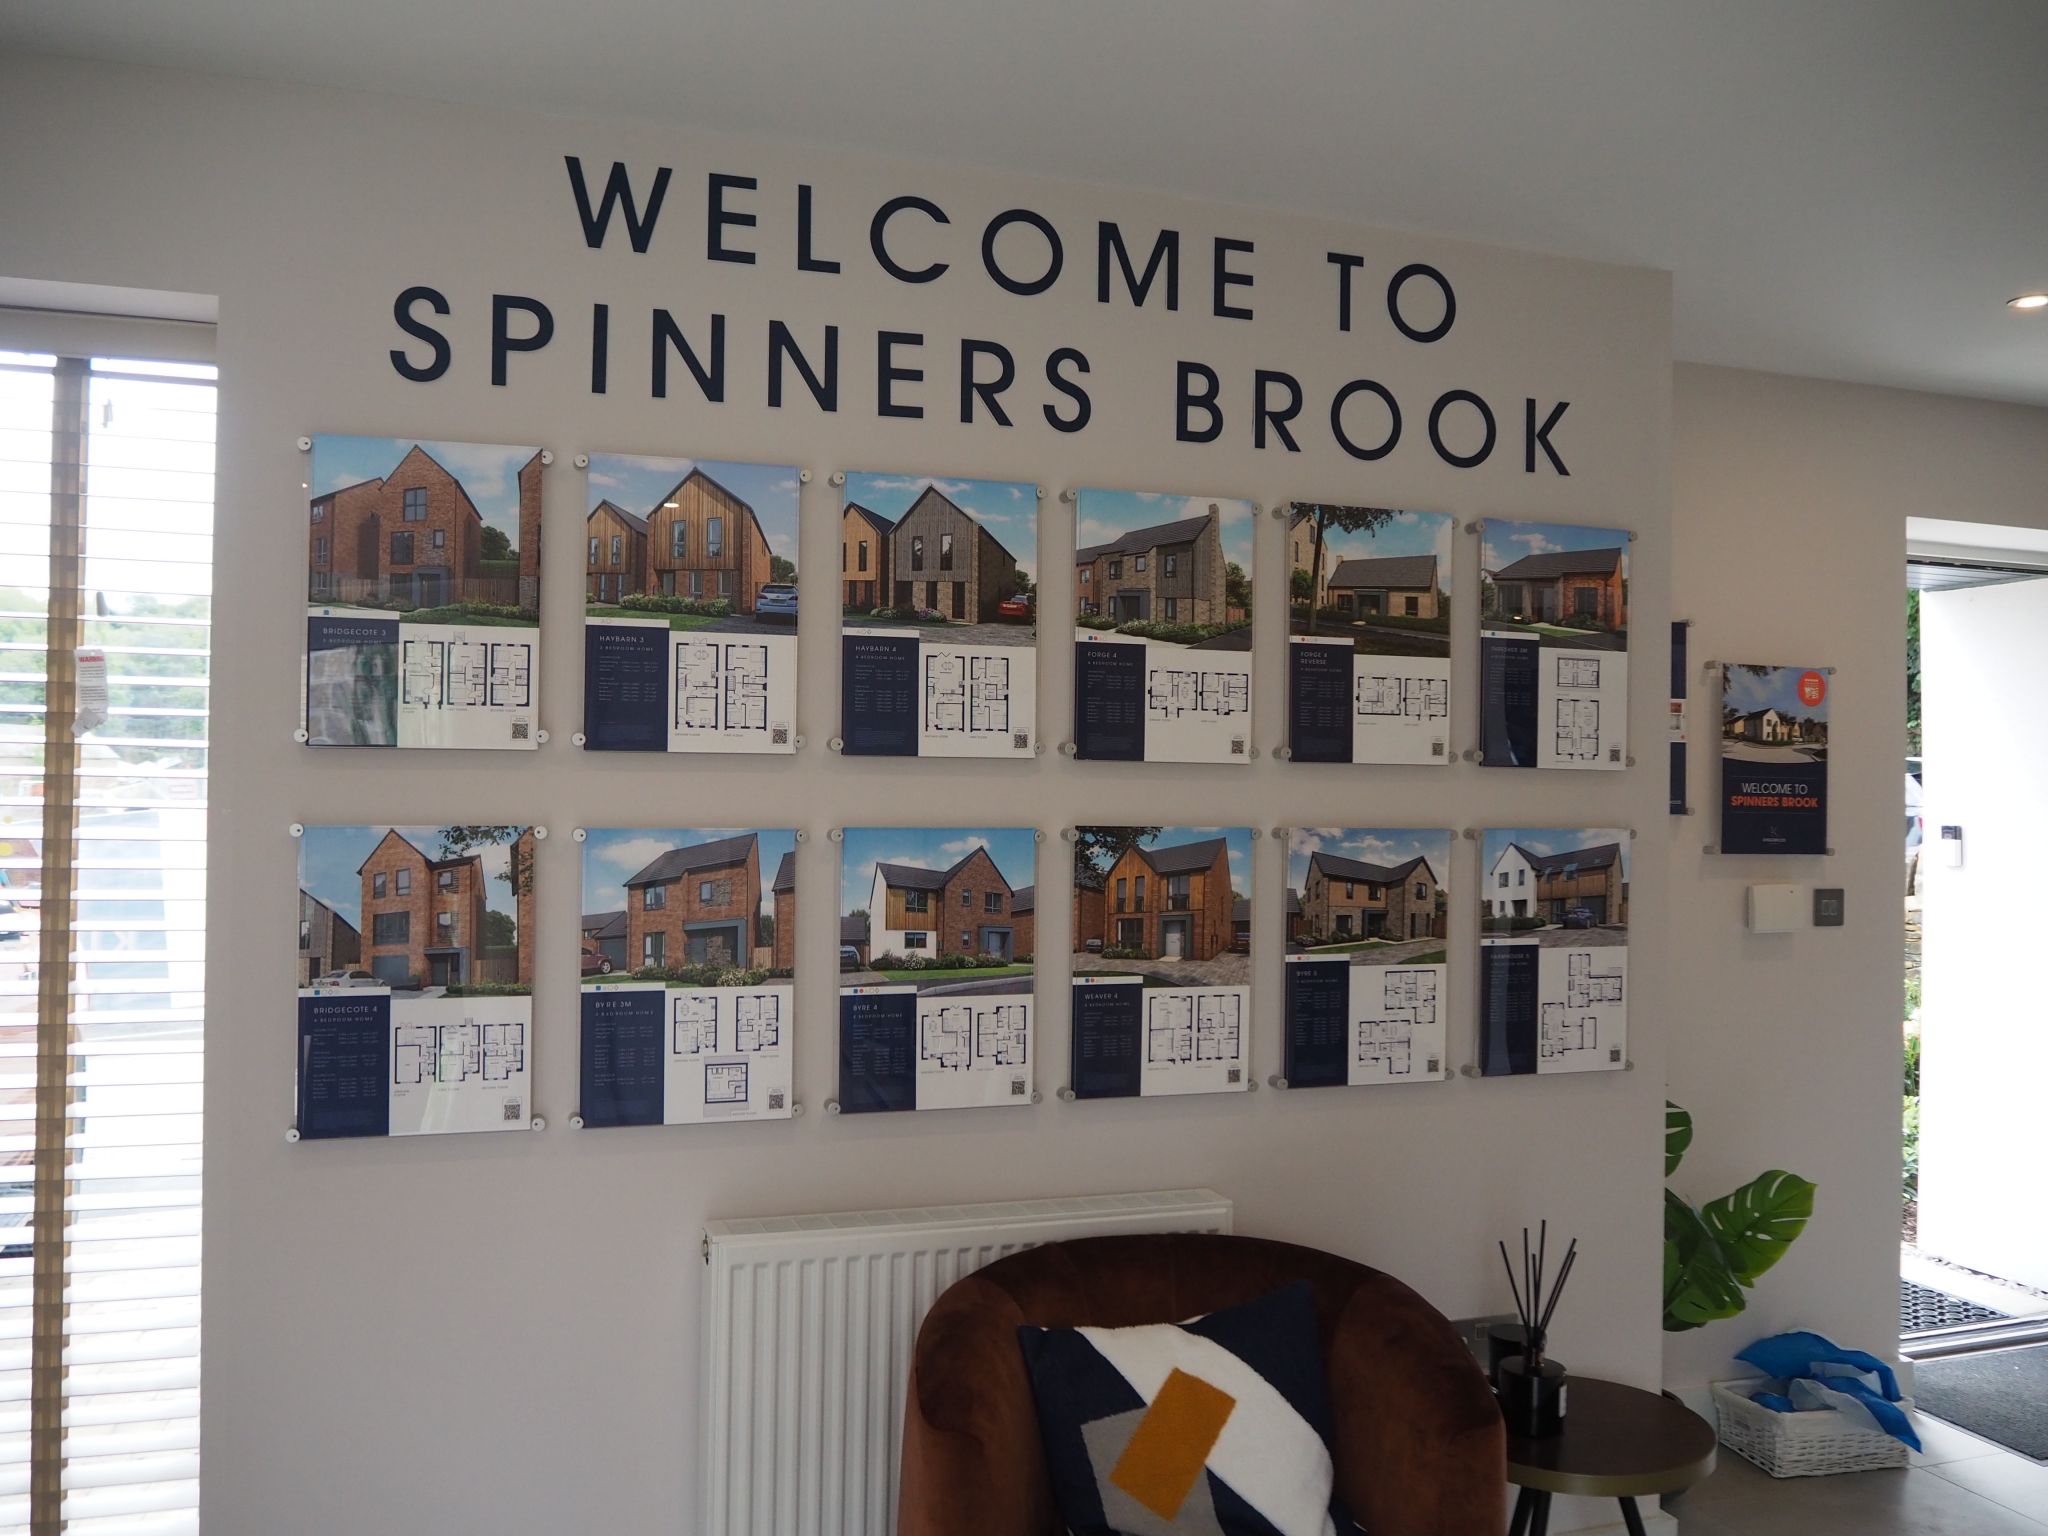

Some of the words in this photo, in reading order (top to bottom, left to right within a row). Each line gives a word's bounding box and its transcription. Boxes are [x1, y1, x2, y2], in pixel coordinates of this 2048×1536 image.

[564, 156, 1255, 320] WELCOME
[1327, 252, 1456, 343] TO
[390, 286, 1091, 433] SPINNERS
[1176, 360, 1571, 476] BROOK
[323, 627, 379, 636] BRIDGECOTE
[599, 635, 637, 643] HAYBARN
[1741, 783, 1792, 794] WELCOME
[1794, 784, 1808, 795] TO
[1731, 796, 1780, 807] SPINNERS
[1782, 797, 1818, 808] BROOK
[595, 1001, 617, 1009] BYRE
[313, 1006, 369, 1015] BRIDGECOTE
